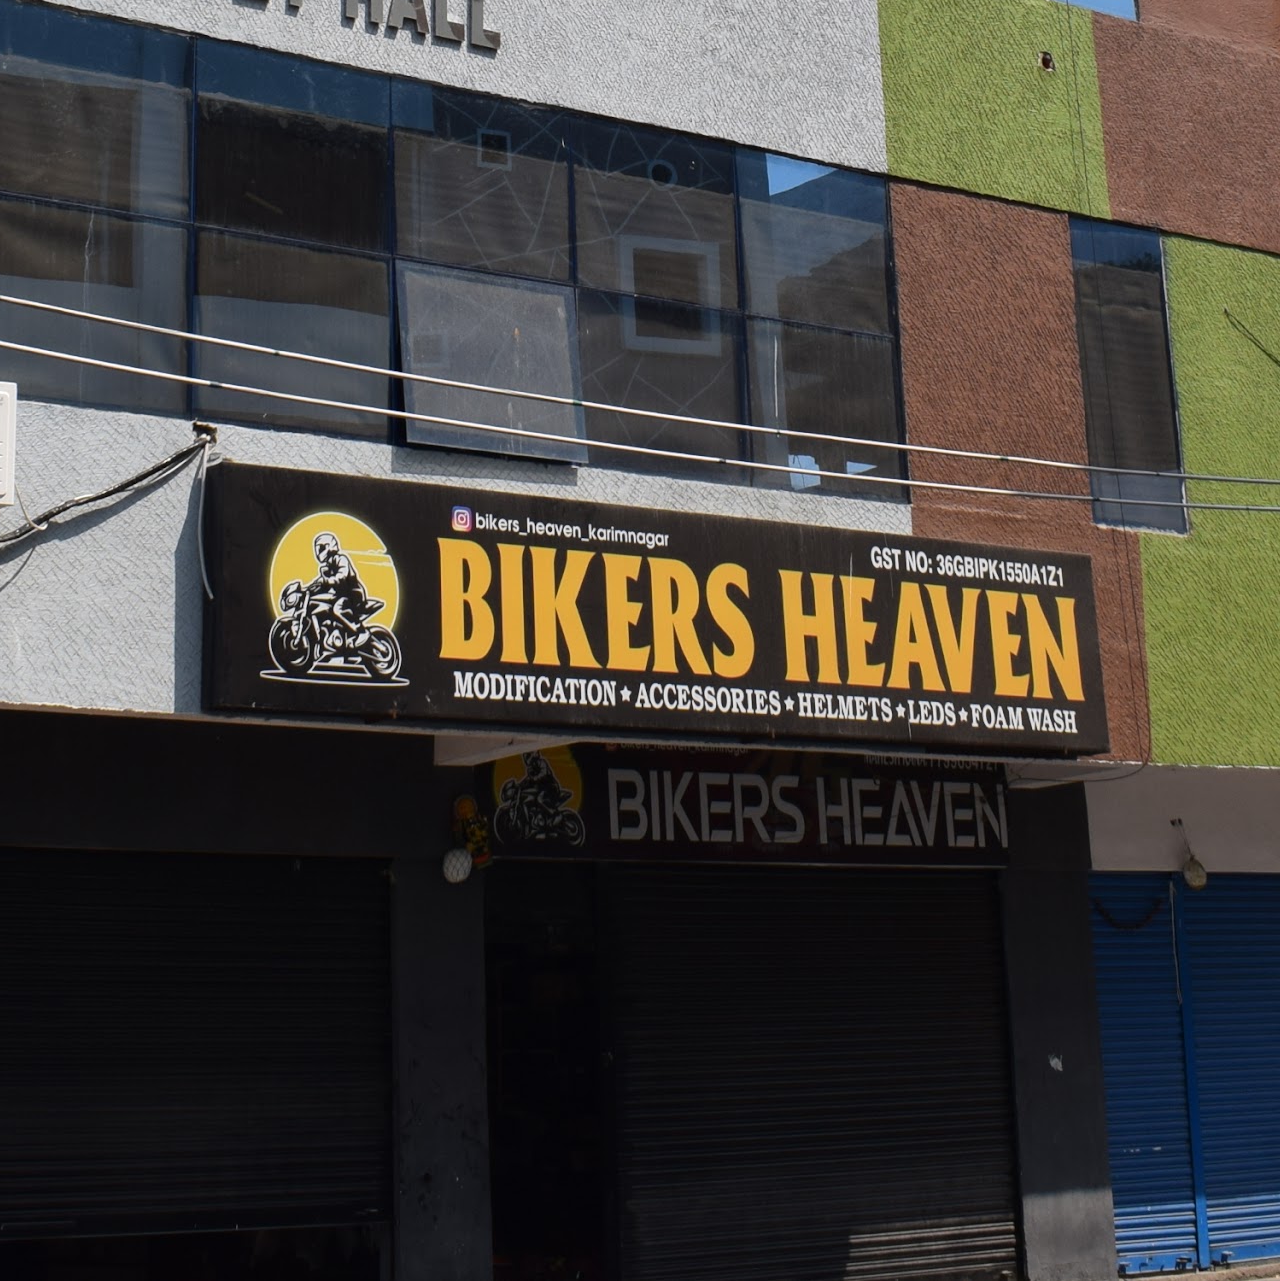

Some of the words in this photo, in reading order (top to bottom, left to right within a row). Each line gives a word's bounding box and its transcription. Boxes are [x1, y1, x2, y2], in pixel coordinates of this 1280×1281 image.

[475, 512, 669, 549] bikers_heaven_karimnagar
[870, 546, 901, 571] GST
[905, 550, 932, 574] NO:
[437, 537, 755, 679] BIKERS
[779, 569, 1085, 701] HEAVEN
[453, 671, 616, 707] MODIFICATION
[635, 682, 781, 716] ACCESSORIES
[798, 693, 892, 722] HELMETS
[908, 699, 957, 727] LEDS
[971, 703, 1023, 731] FOAM
[1027, 708, 1077, 734] WASH
[607, 768, 806, 844] BIKERS
[817, 776, 1008, 849] HEAVEN
